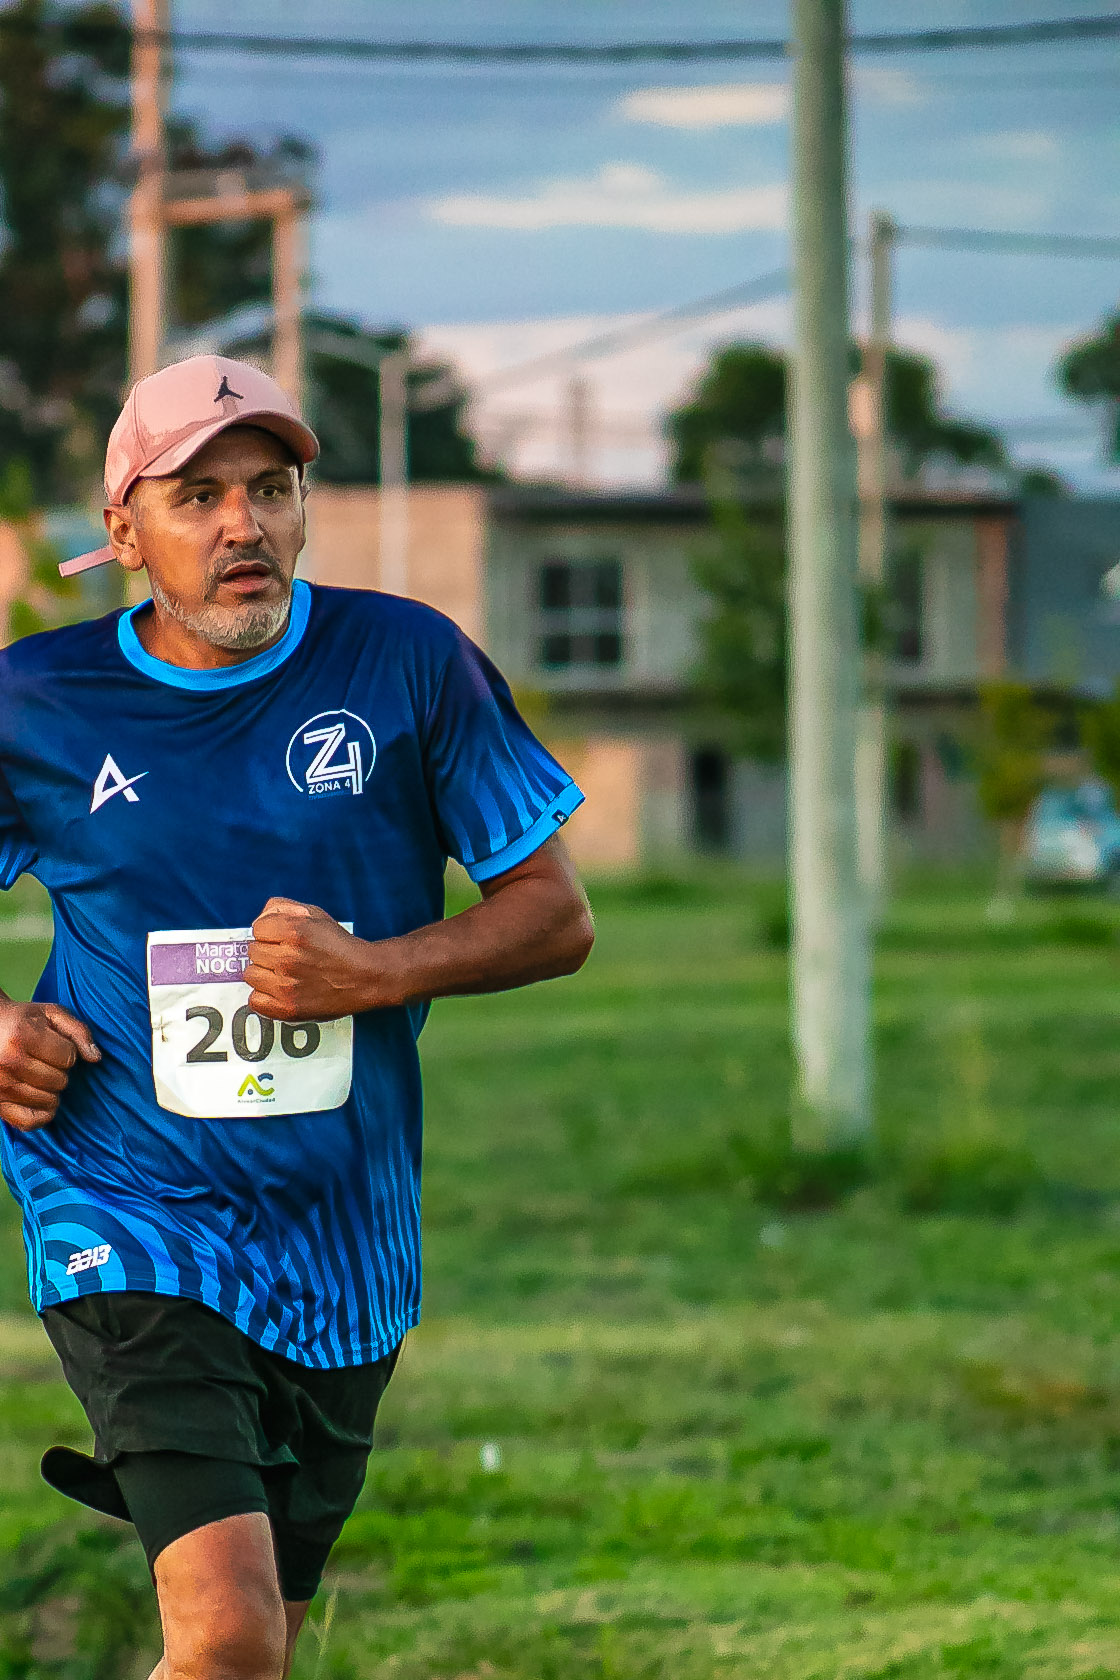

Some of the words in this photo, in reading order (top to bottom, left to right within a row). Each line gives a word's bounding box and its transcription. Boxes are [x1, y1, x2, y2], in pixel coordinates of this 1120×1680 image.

[308, 780, 341, 795] ZONA
[344, 778, 351, 789] 4
[196, 956, 254, 974] NOCT
[185, 1004, 321, 1063] 206
